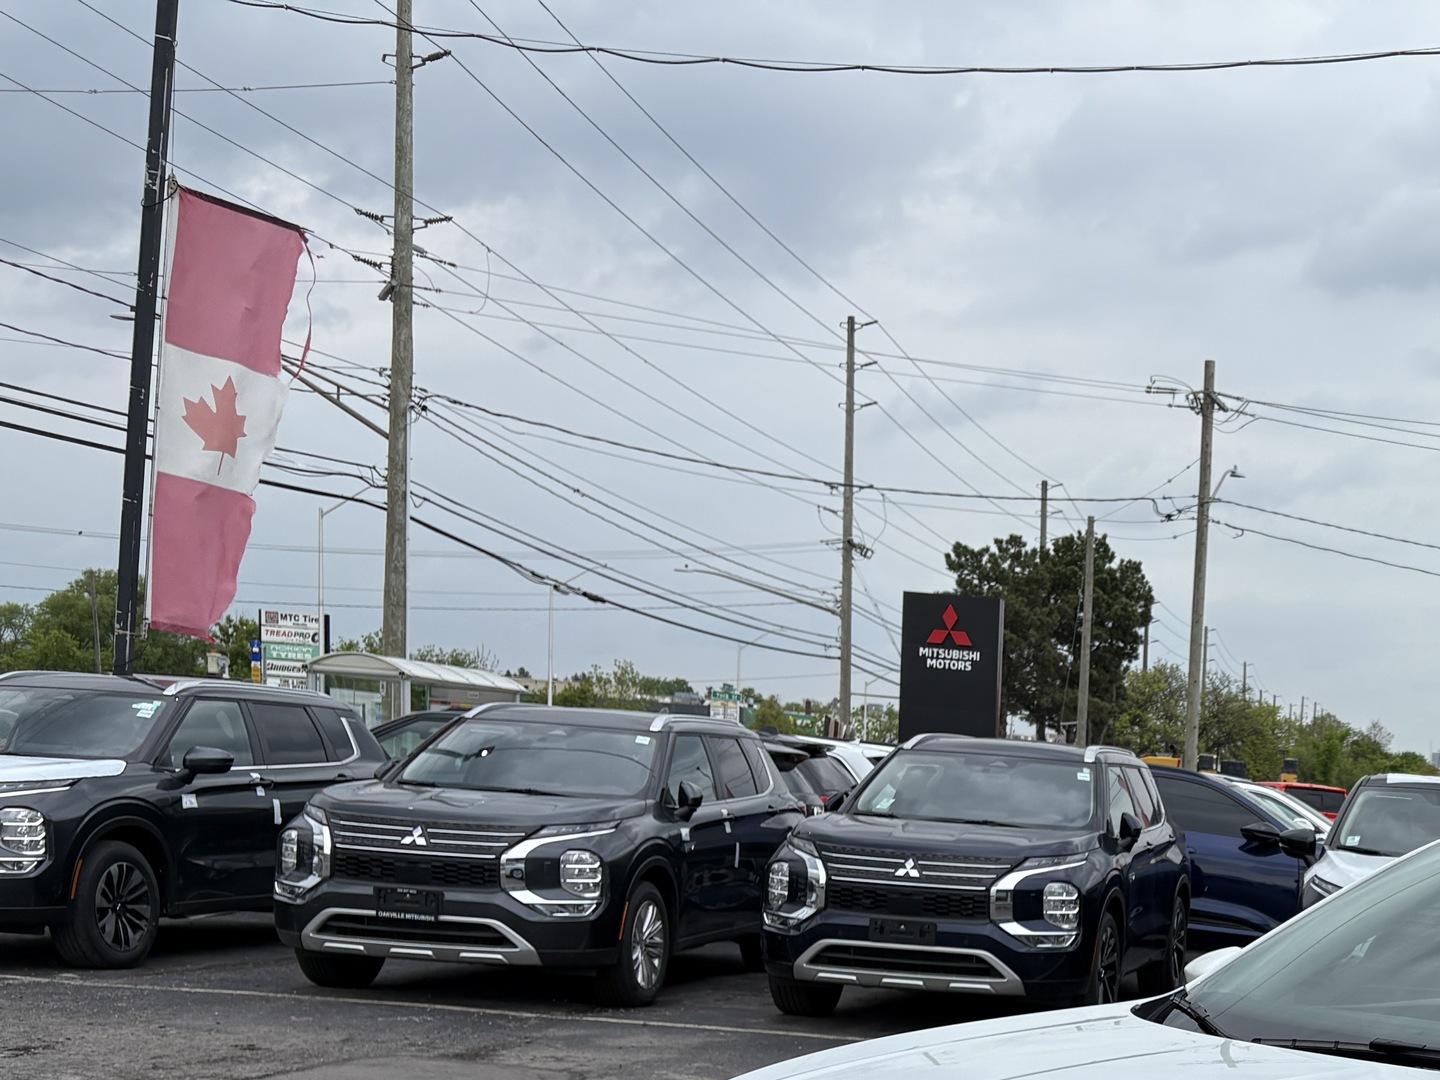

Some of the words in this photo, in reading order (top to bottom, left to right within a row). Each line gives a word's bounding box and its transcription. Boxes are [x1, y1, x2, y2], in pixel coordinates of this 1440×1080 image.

[303, 614, 319, 624] Tire
[265, 629, 311, 641] TREADPRO
[919, 647, 980, 661] MITSUBISHI
[926, 658, 972, 671] MOTORS
